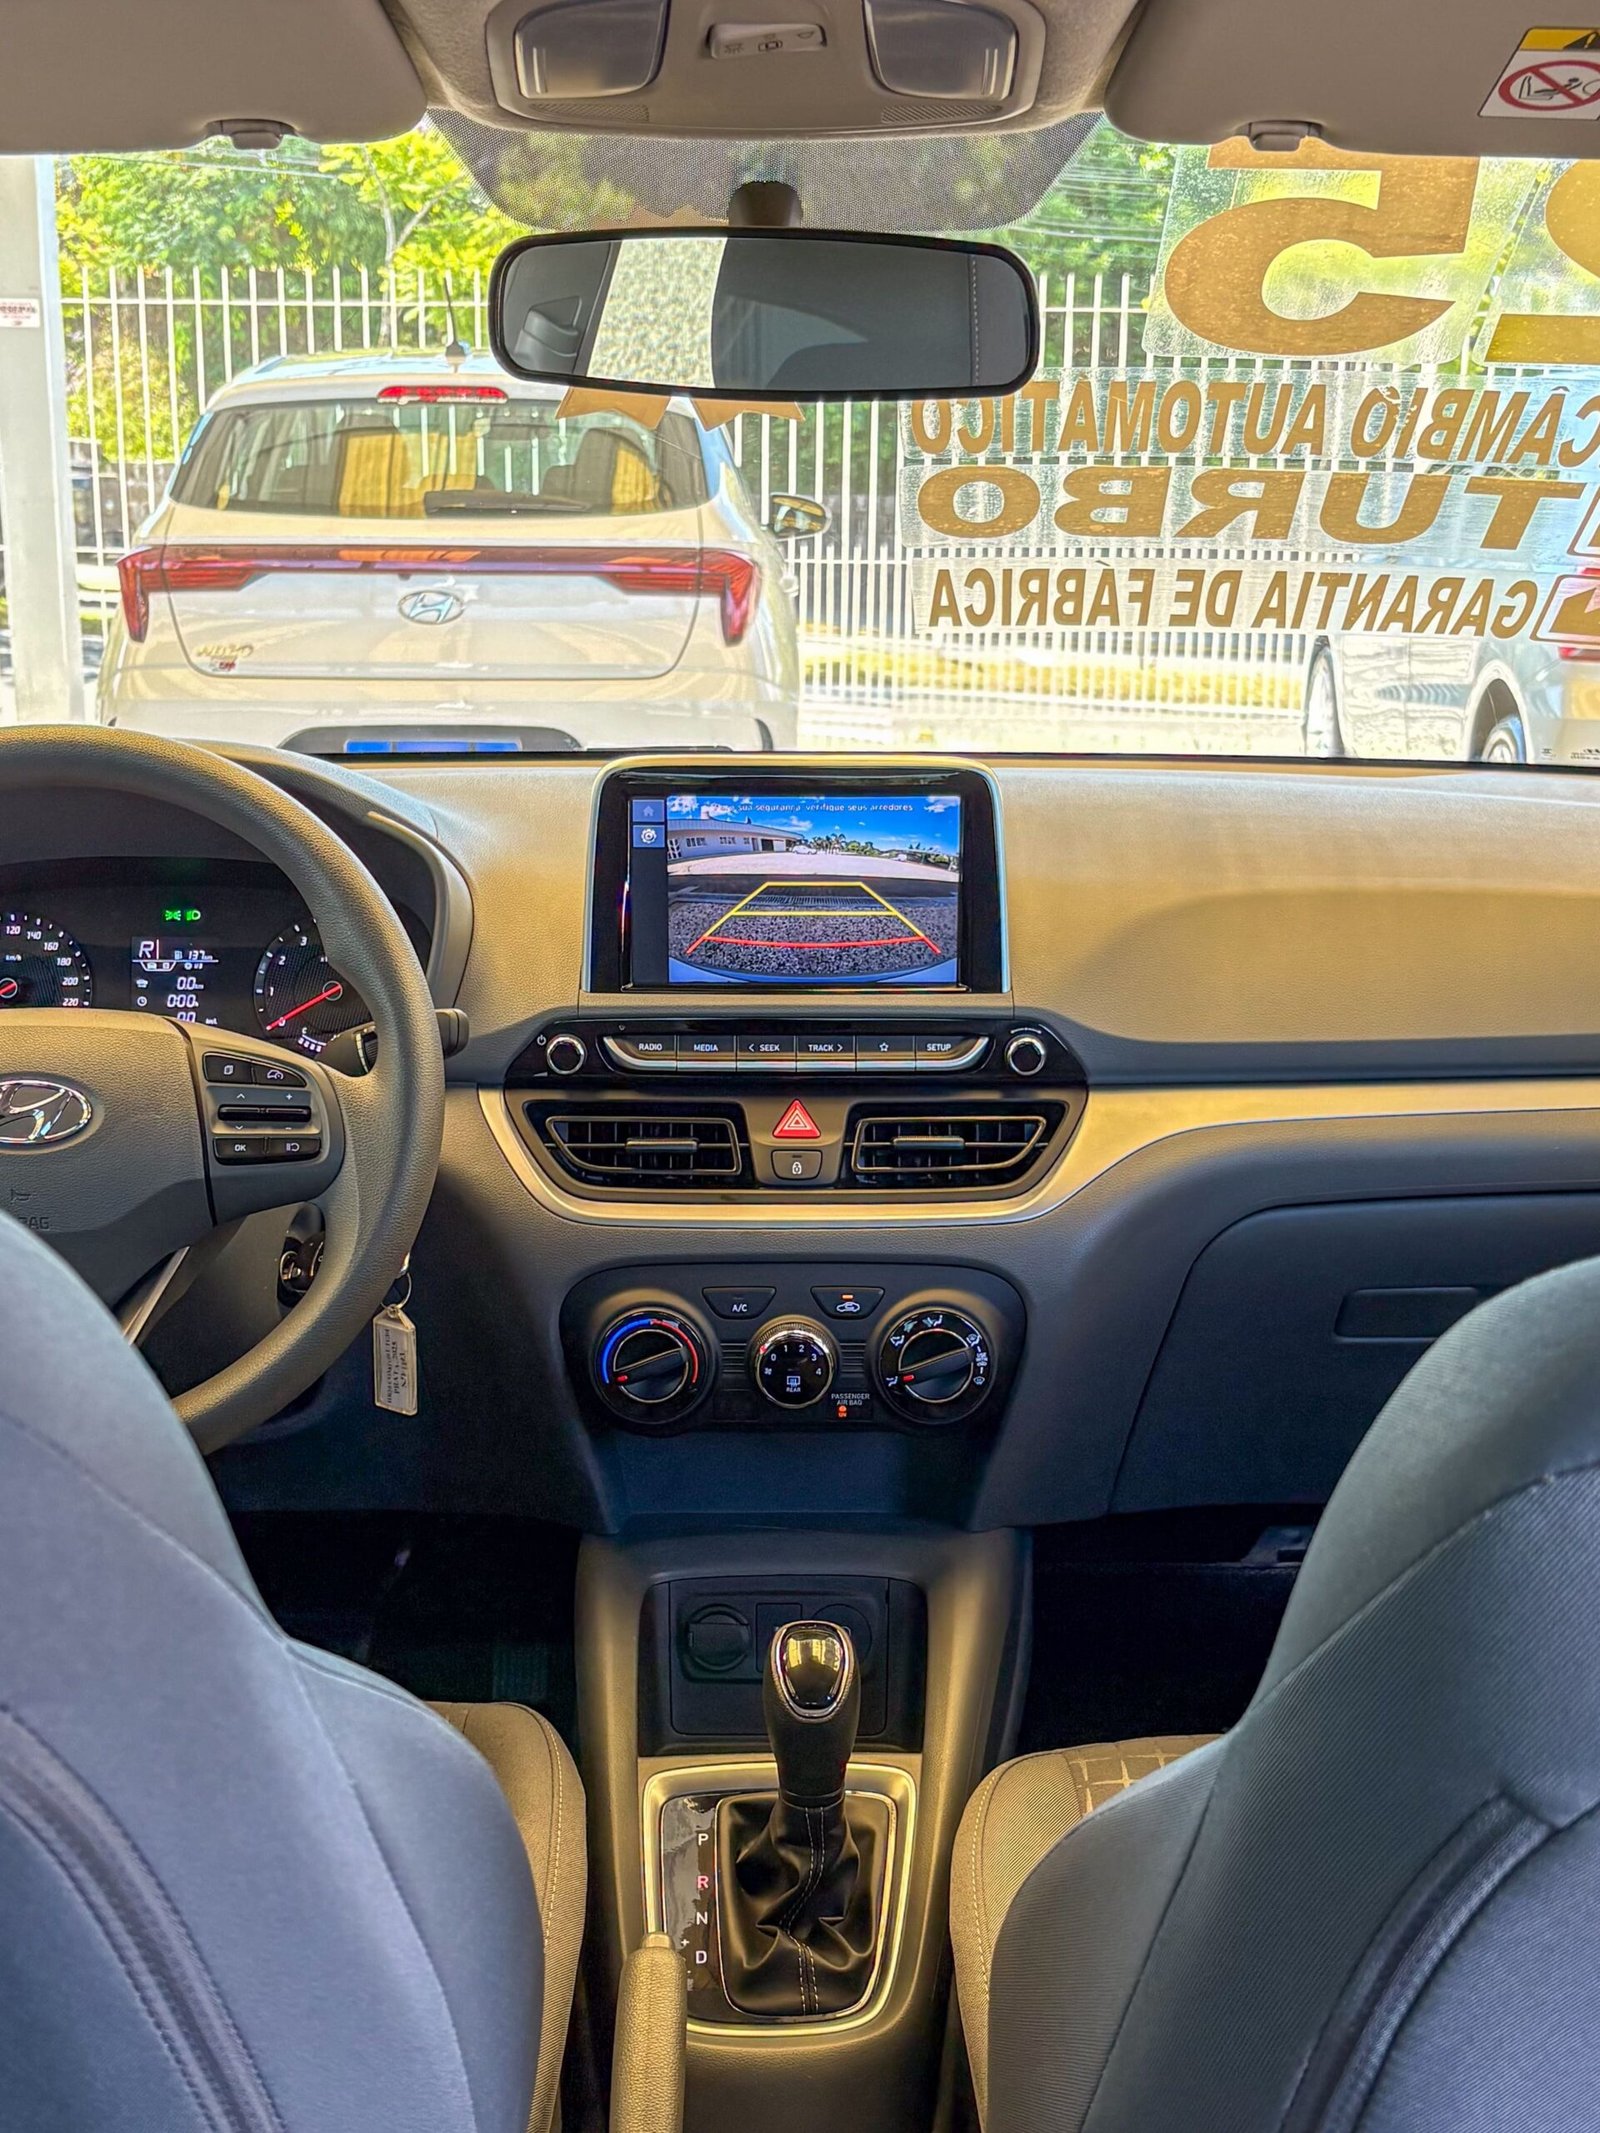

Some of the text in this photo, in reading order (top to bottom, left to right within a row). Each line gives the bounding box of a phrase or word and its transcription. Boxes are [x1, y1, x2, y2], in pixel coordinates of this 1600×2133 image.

[6, 926, 21, 935] 120
[26, 931, 42, 940] 140
[300, 936, 307, 946] 3
[44, 942, 59, 951] 160
[139, 941, 154, 959] R
[57, 957, 72, 966] 180
[278, 956, 286, 965] 2
[62, 977, 79, 986] 200
[269, 987, 274, 996] 1
[62, 998, 79, 1006] 220
[638, 1042, 663, 1051] RADIO
[693, 1043, 719, 1052] MEDIA
[759, 1043, 780, 1052] SEEK
[808, 1043, 834, 1052] TRACK
[926, 1042, 951, 1052] SETUP
[234, 1144, 246, 1152] OK
[732, 1303, 748, 1313] A/C
[783, 1344, 788, 1352] 1
[798, 1344, 805, 1352] 2
[811, 1353, 817, 1361] 3
[698, 1833, 709, 1846] P
[697, 1875, 709, 1889] R
[696, 1911, 708, 1925] N
[695, 1950, 707, 1964] D
